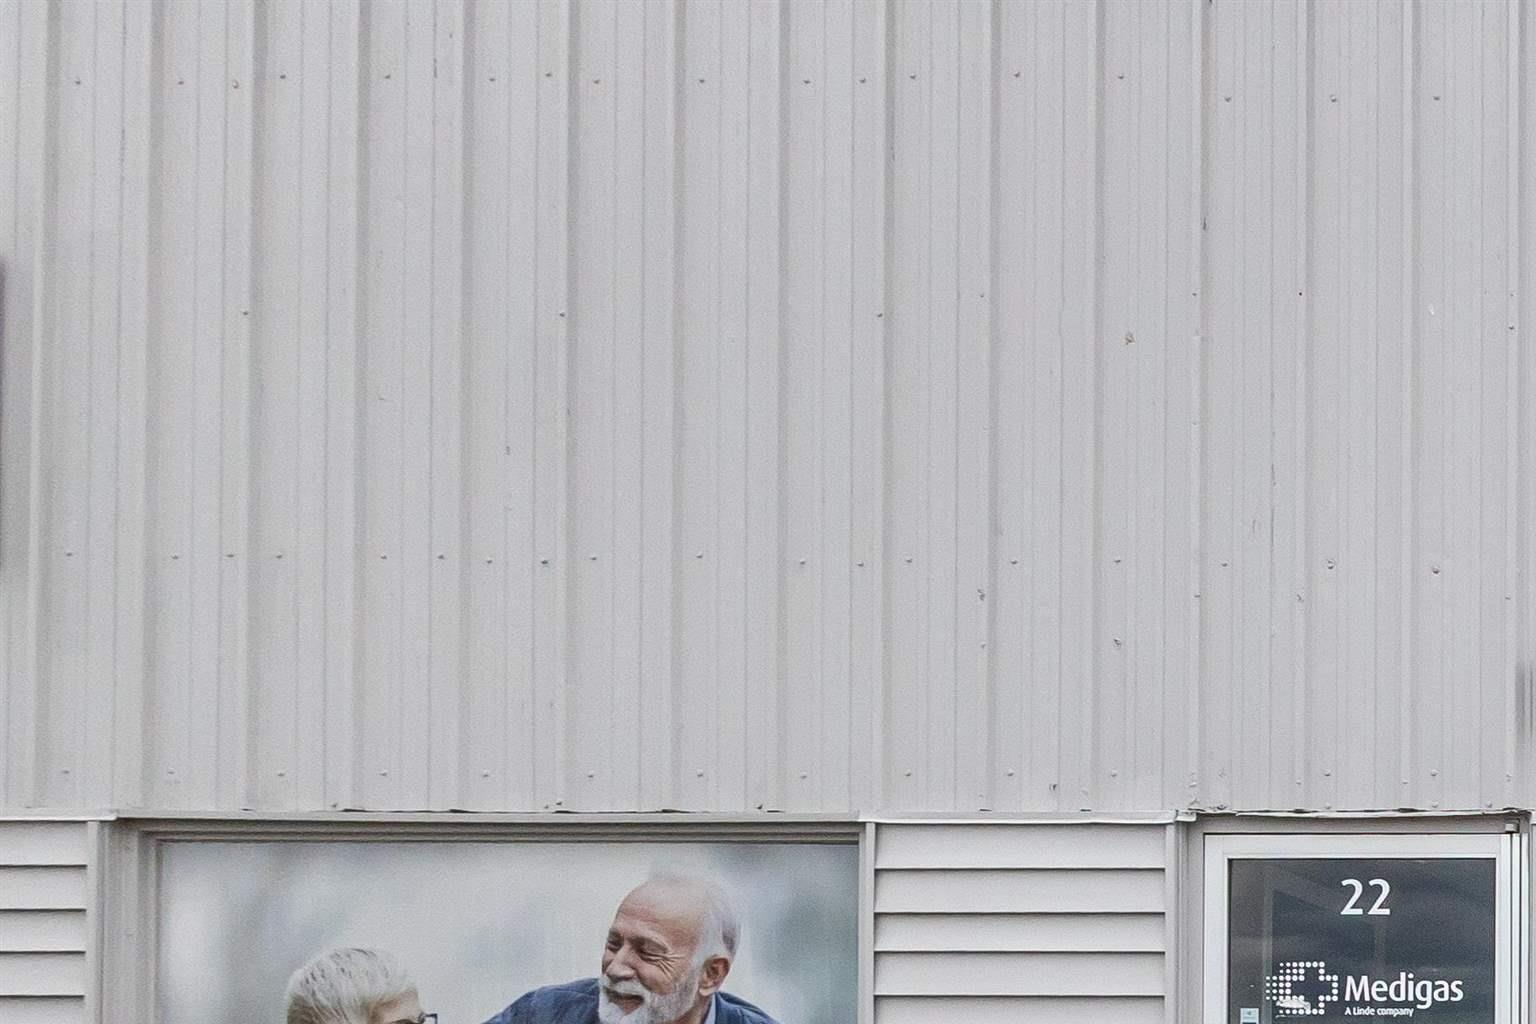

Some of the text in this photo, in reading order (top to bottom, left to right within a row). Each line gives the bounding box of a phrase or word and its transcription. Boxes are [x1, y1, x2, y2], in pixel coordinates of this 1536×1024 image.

[1340, 878, 1391, 915] 22
[1344, 972, 1464, 1010] Medigas
[1344, 1007, 1414, 1018] A Linde company
